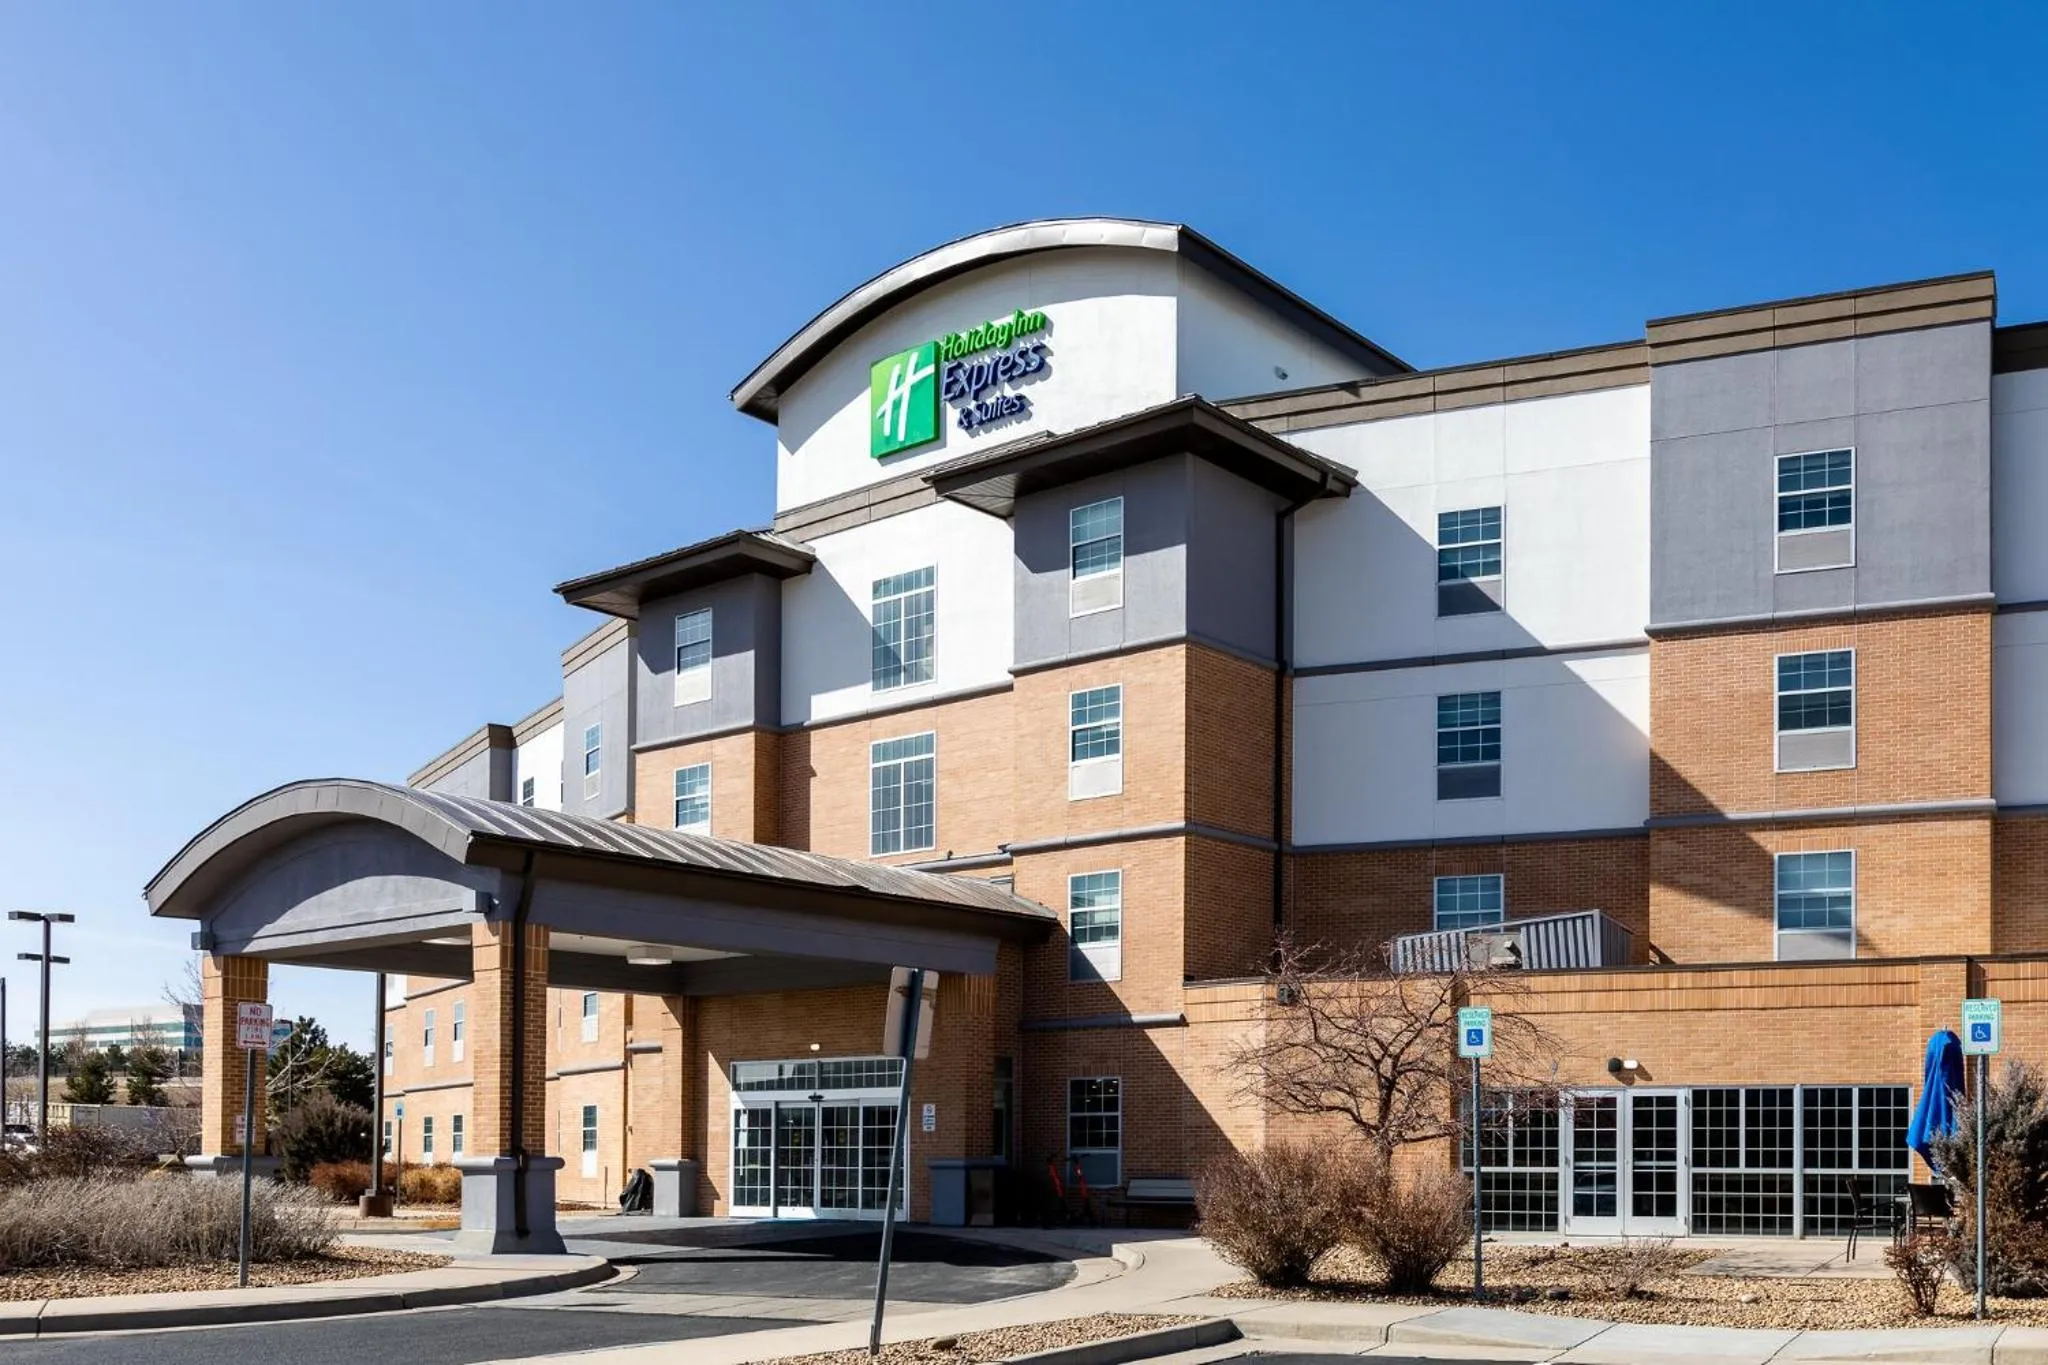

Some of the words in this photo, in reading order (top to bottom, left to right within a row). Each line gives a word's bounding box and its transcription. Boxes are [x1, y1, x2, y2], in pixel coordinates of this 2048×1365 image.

[940, 322, 1013, 361] Holiday
[1012, 309, 1046, 337] Inn
[942, 343, 1046, 400] Express
[957, 407, 974, 429] &
[973, 393, 1025, 425] Suites
[240, 1017, 270, 1027] PARKING
[249, 1007, 262, 1016] NO
